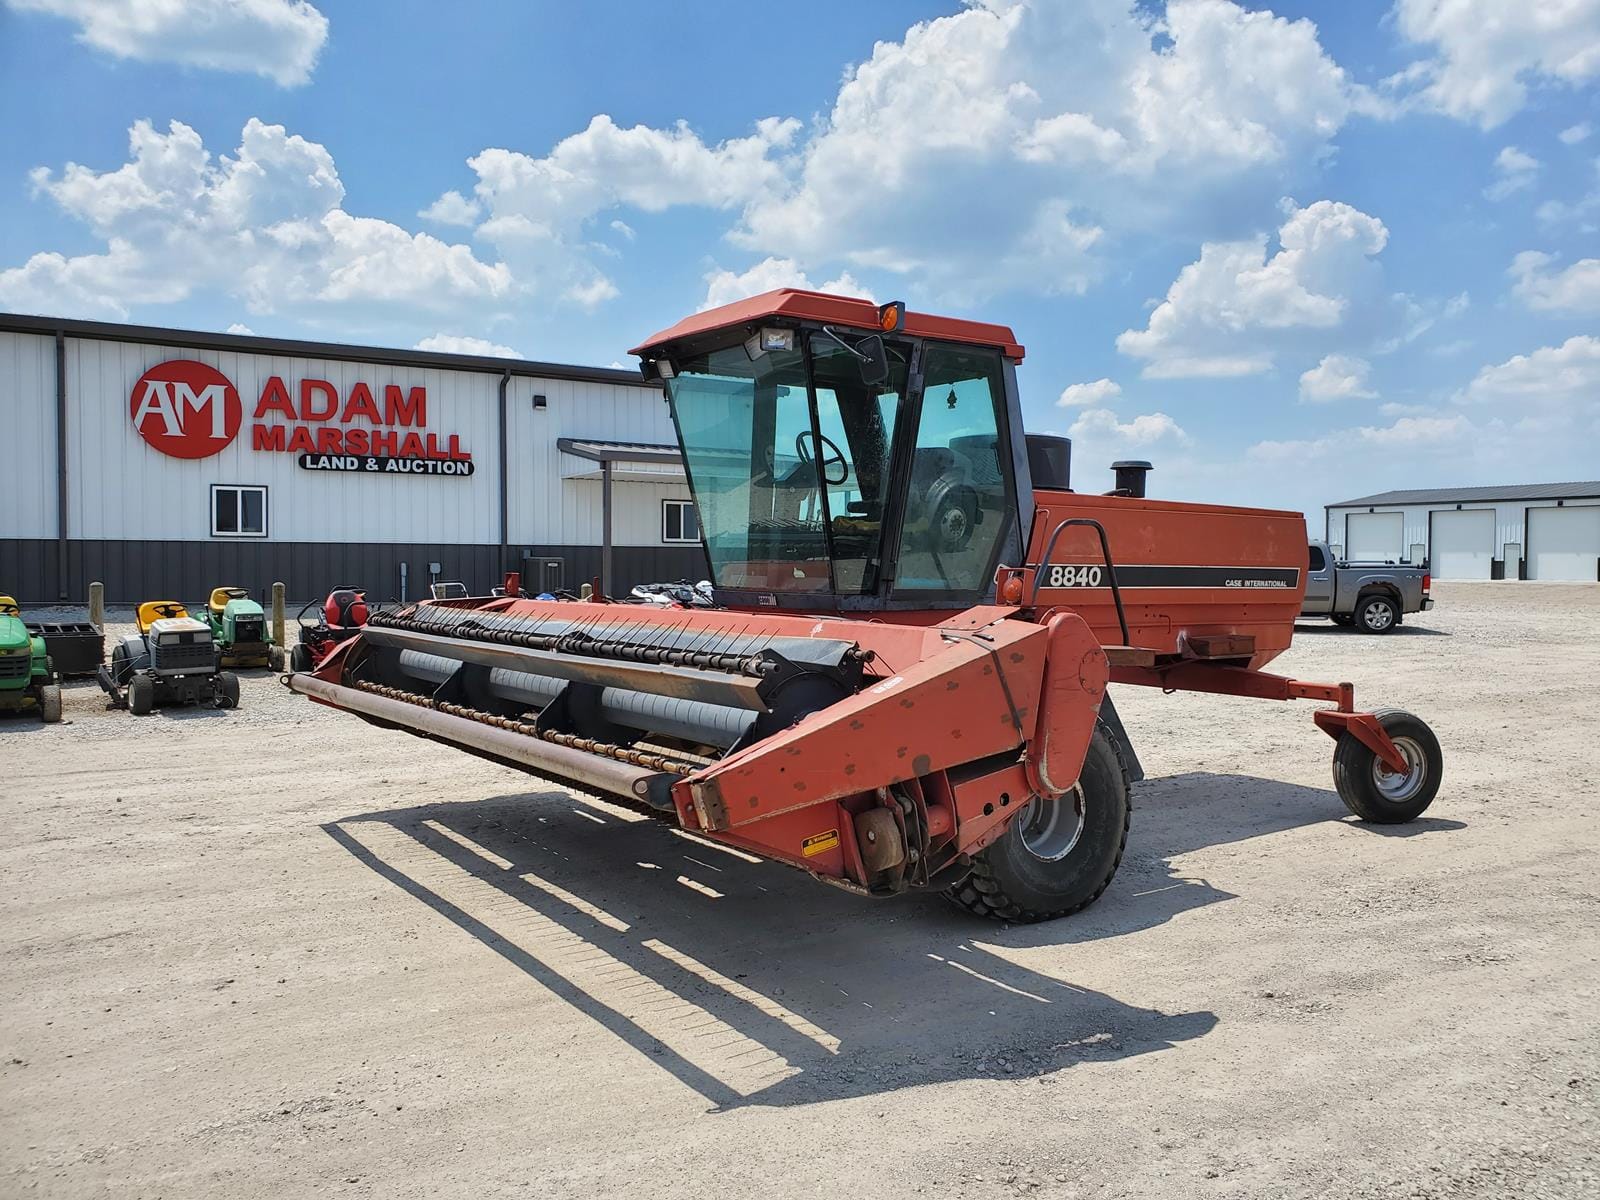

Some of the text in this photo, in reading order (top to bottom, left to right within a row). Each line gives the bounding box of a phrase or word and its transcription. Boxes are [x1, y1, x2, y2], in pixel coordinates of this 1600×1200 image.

[133, 379, 230, 439] AM
[252, 376, 427, 427] ADAM
[252, 423, 472, 460] MARSHALL
[305, 455, 470, 475] LAND & AUCTION
[1050, 566, 1102, 587] 8840
[1225, 579, 1288, 588] CASE INTERNATIONAL
